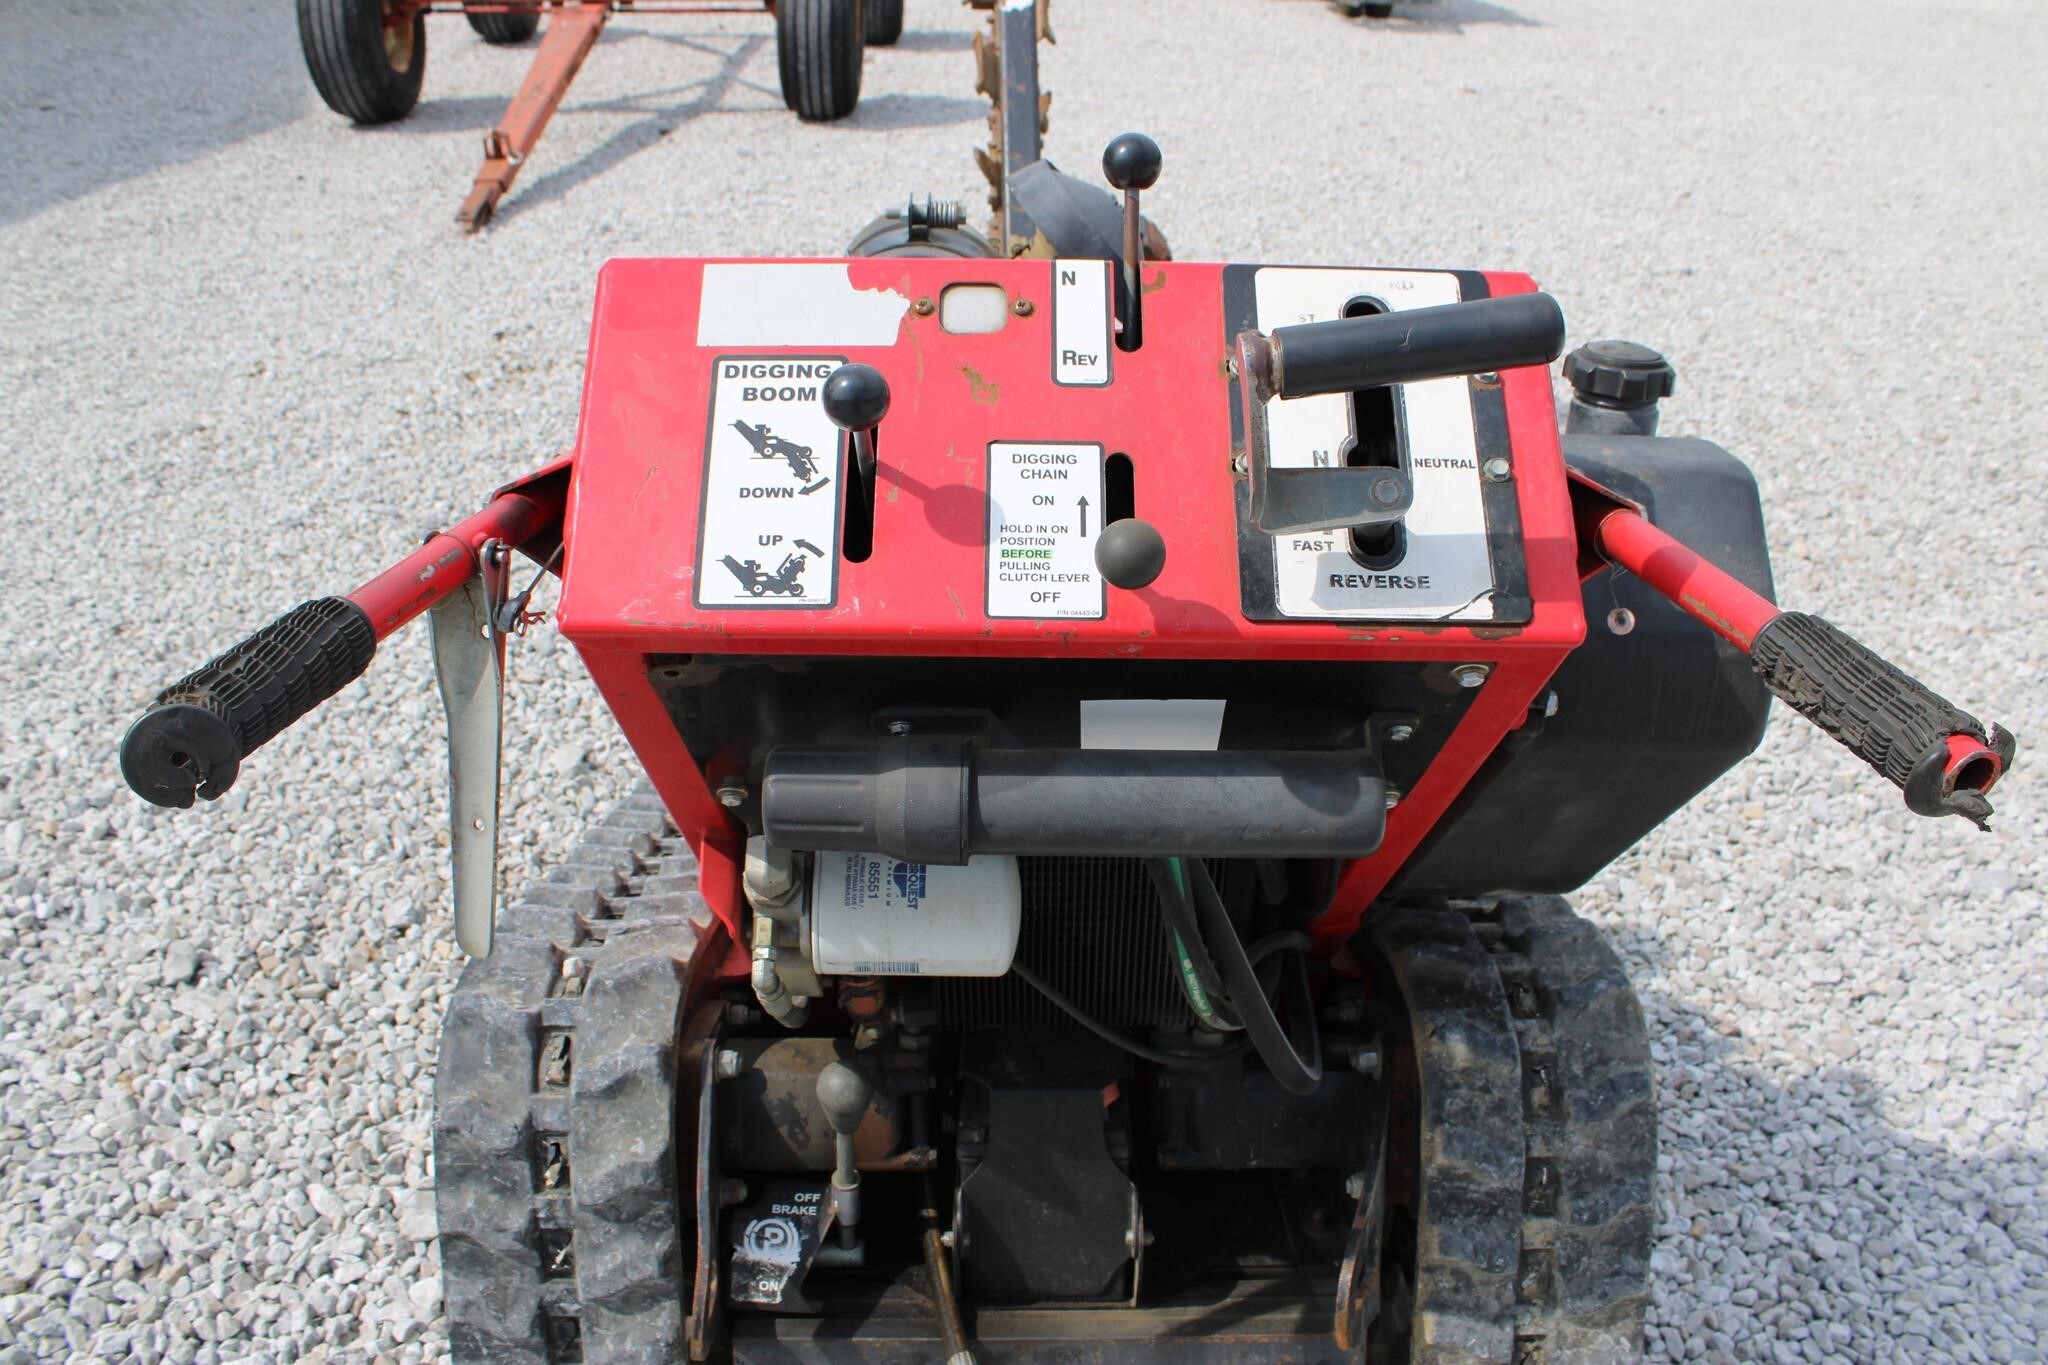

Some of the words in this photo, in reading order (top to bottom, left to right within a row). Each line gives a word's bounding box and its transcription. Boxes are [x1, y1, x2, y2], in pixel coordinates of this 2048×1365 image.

[1061, 270, 1076, 286] N
[724, 364, 832, 379] DIGGING
[742, 386, 817, 402] BOOM
[1012, 453, 1078, 465] DIGGING
[1414, 457, 1477, 469] NEUTRAL
[1020, 468, 1068, 480] CHAIN
[739, 487, 794, 498] DOWN
[1032, 495, 1055, 506] ON
[1000, 524, 1033, 534] HOLD
[1036, 525, 1048, 534] IN
[1051, 525, 1068, 534] ON
[758, 535, 783, 546] UP
[1000, 537, 1056, 546] POSITION
[1293, 539, 1335, 552] FAST
[1001, 549, 1051, 559] BEFORE
[999, 561, 1051, 571] PULLING
[999, 573, 1047, 582] CLUTCH
[1051, 573, 1090, 583] LEVER
[1329, 574, 1431, 589] REVERSE
[1030, 591, 1061, 603] OFF
[868, 861, 880, 898] 85551
[794, 1193, 821, 1203] OFF
[771, 1204, 818, 1216] BRAKE
[758, 1280, 779, 1292] ON
